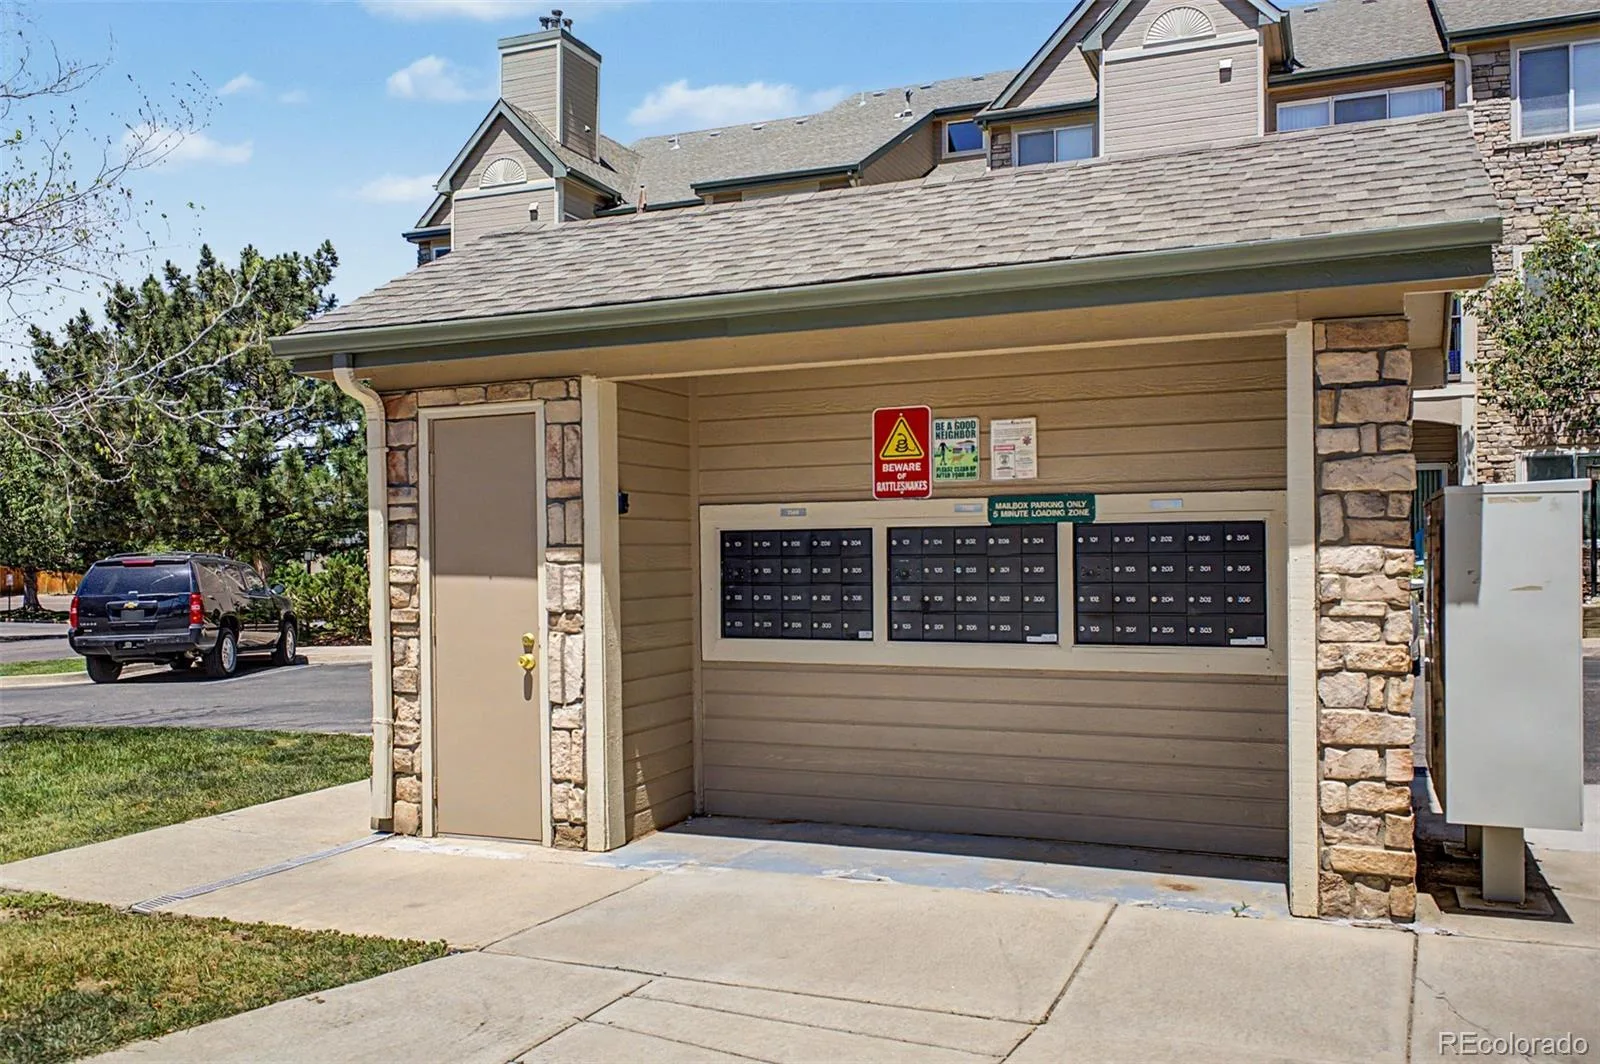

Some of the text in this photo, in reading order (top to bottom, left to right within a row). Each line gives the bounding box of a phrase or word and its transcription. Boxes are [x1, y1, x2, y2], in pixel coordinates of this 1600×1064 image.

[936, 421, 976, 430] BE A GOOD
[936, 430, 976, 440] NEIGHBOR
[882, 462, 922, 472] BEWARE
[876, 480, 928, 492] RATTLESNAKES
